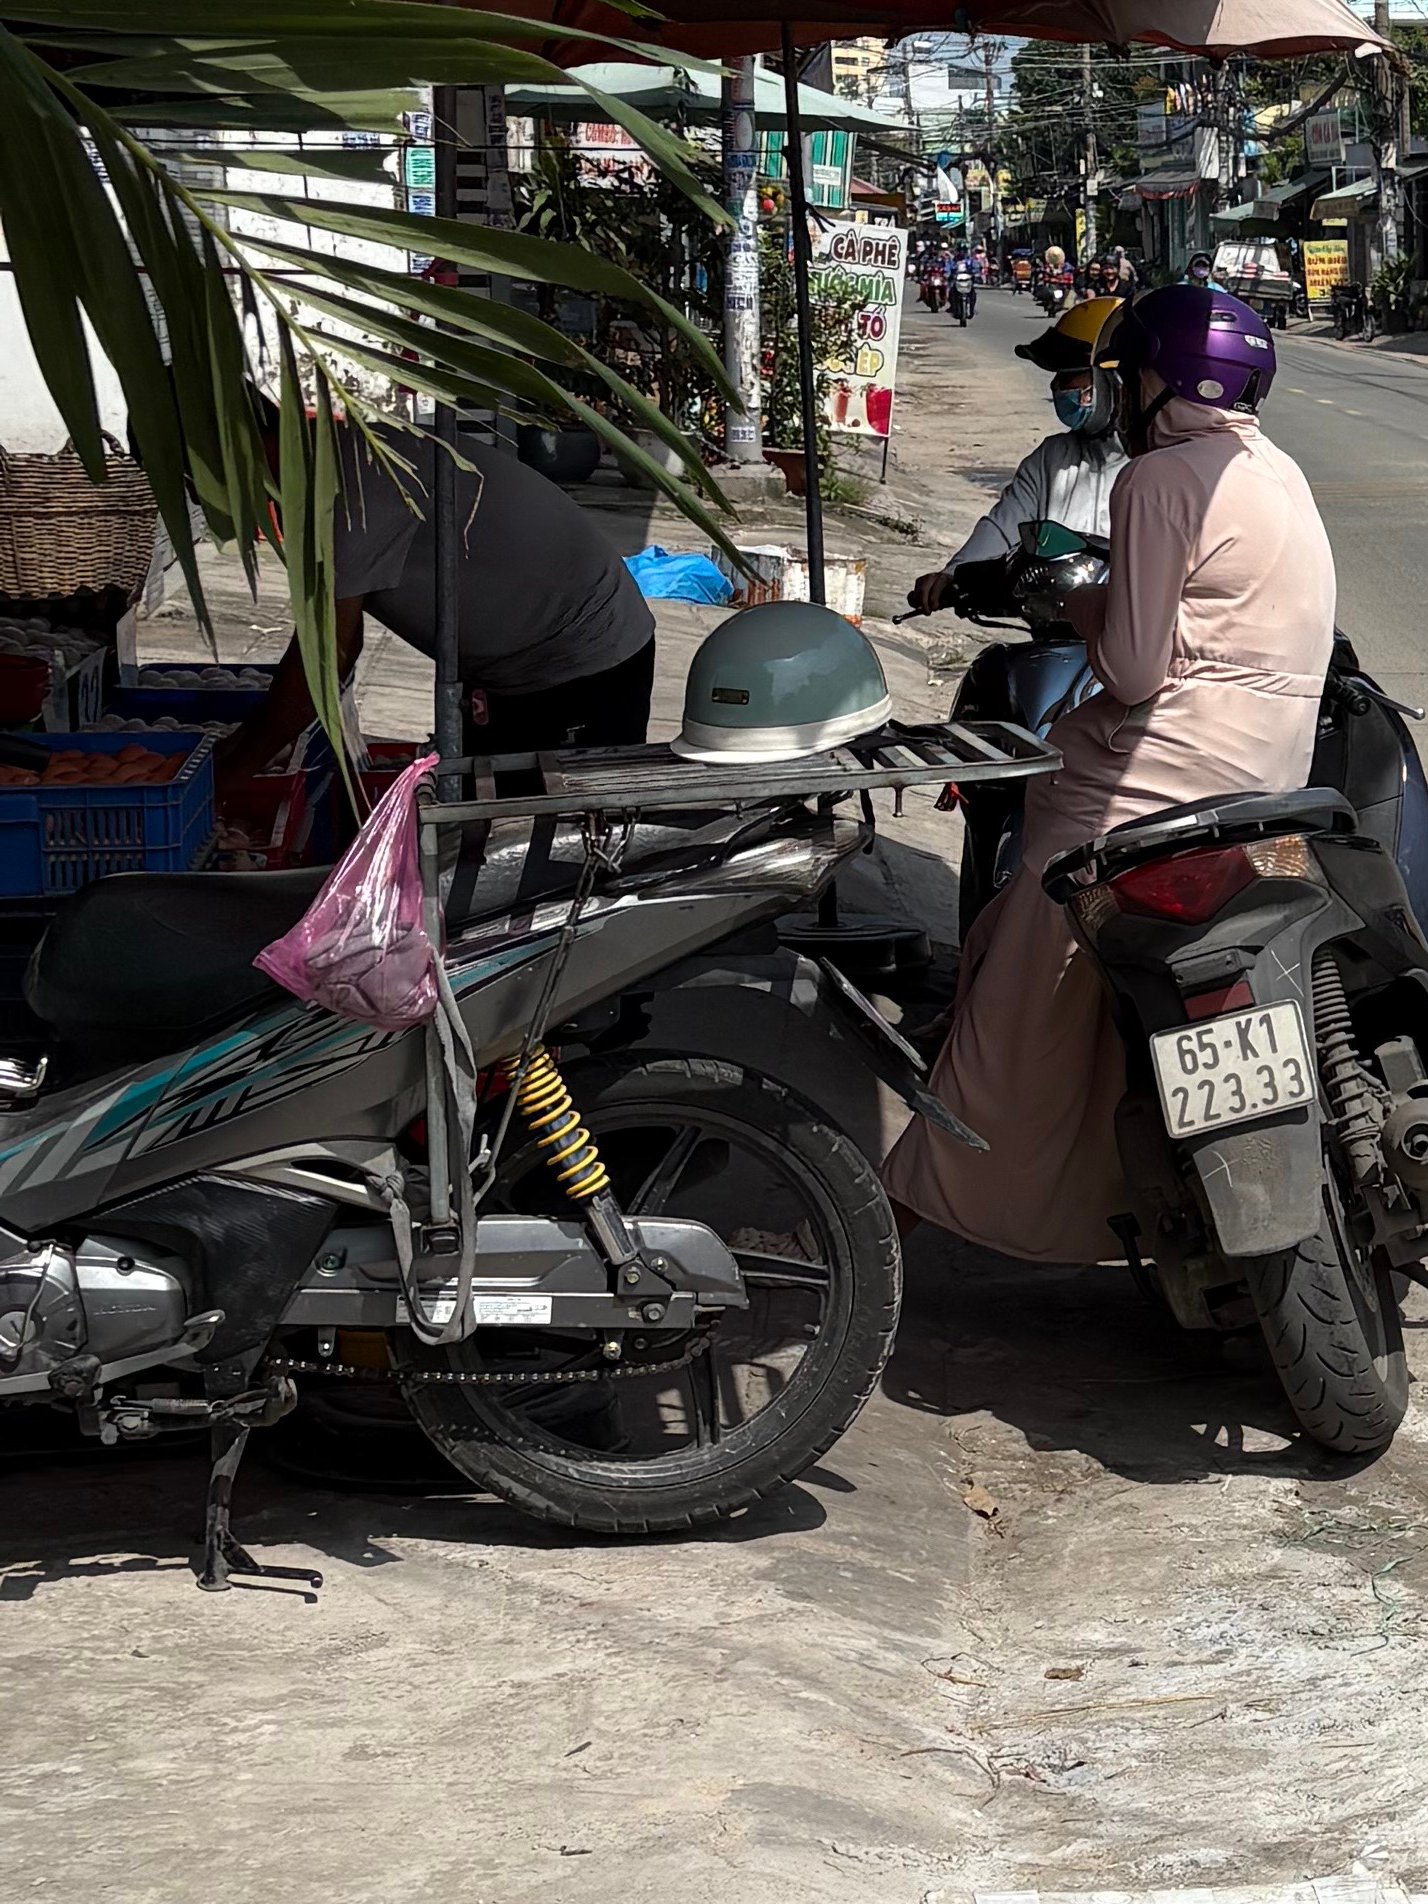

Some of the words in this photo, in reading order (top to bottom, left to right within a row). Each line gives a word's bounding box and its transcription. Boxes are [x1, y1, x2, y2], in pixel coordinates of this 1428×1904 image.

[832, 229, 858, 264] CÀ
[860, 235, 900, 269] PHÊ
[1176, 1013, 1279, 1076] 65-K1
[1171, 1057, 1306, 1130] 223.33
